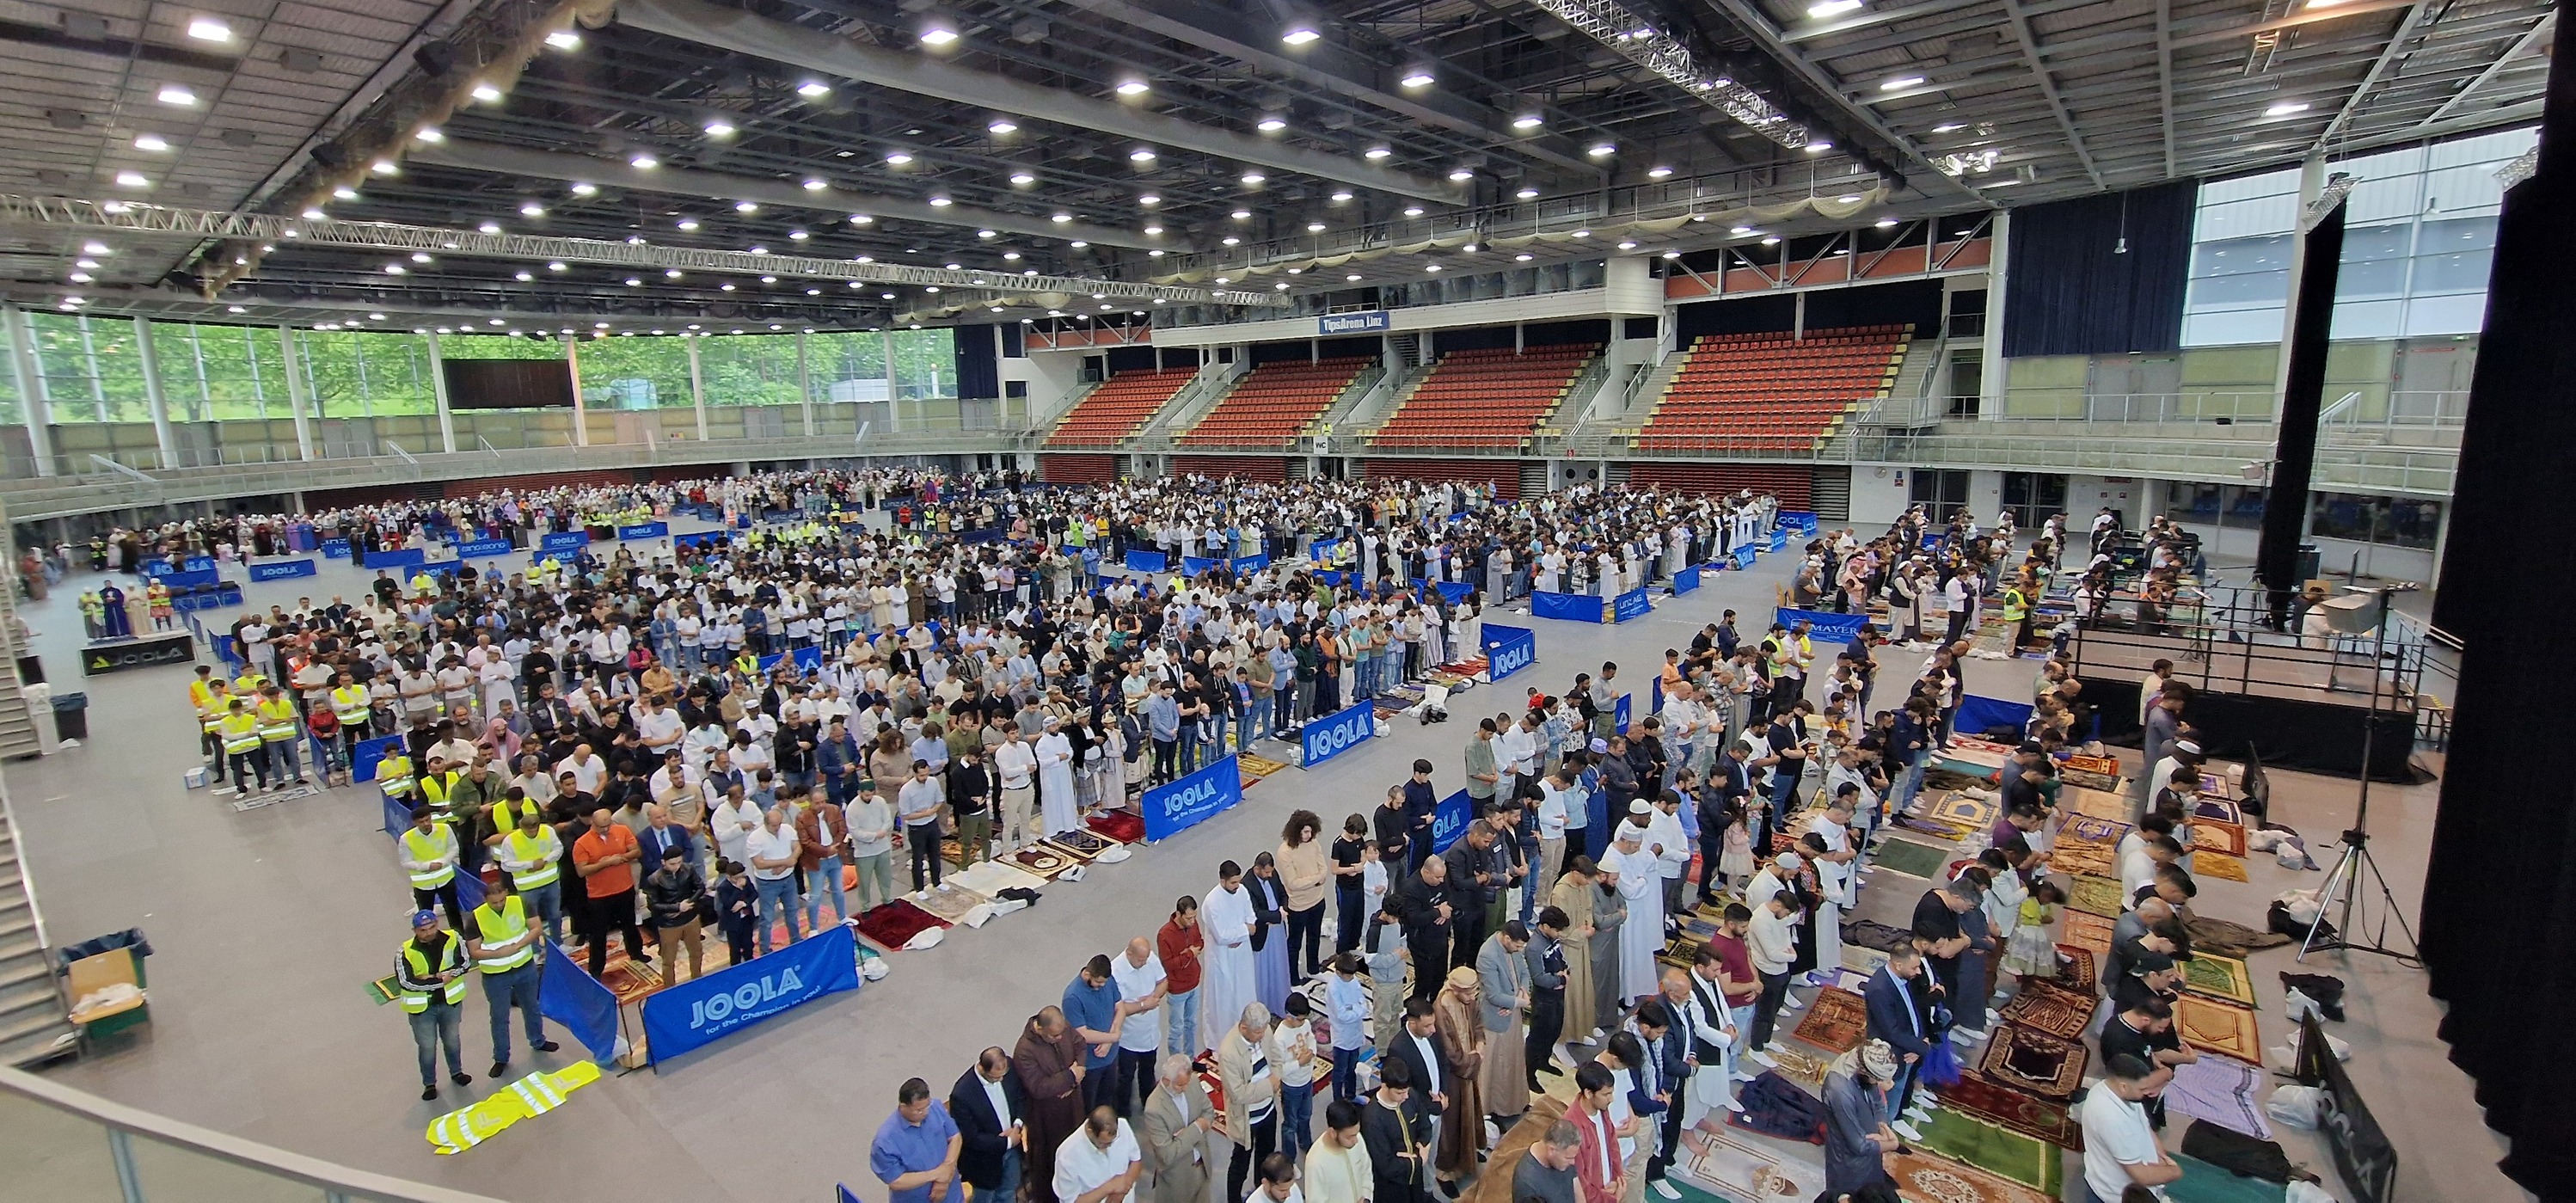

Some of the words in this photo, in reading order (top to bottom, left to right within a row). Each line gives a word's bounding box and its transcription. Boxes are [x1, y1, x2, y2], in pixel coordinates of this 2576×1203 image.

[1323, 317, 1365, 333] TipsArena
[1366, 316, 1383, 328] Linz
[1778, 516, 1803, 525] OOL
[628, 526, 652, 535] JOOLA
[551, 536, 578, 545] JOOLA
[261, 566, 297, 577] JOOLA
[1811, 623, 1857, 635] MAYER
[110, 647, 184, 666] JOOLA
[1494, 643, 1530, 678] JOOLA
[1309, 714, 1370, 762] JOOLA
[1164, 778, 1217, 817] JOOLA
[1432, 809, 1461, 839] OLA
[690, 967, 804, 1030] JOOLA
[706, 1024, 721, 1036] for
[721, 1015, 739, 1028] the
[740, 1003, 790, 1022] Champion
[791, 997, 801, 1006] in
[801, 984, 823, 1002] you!
